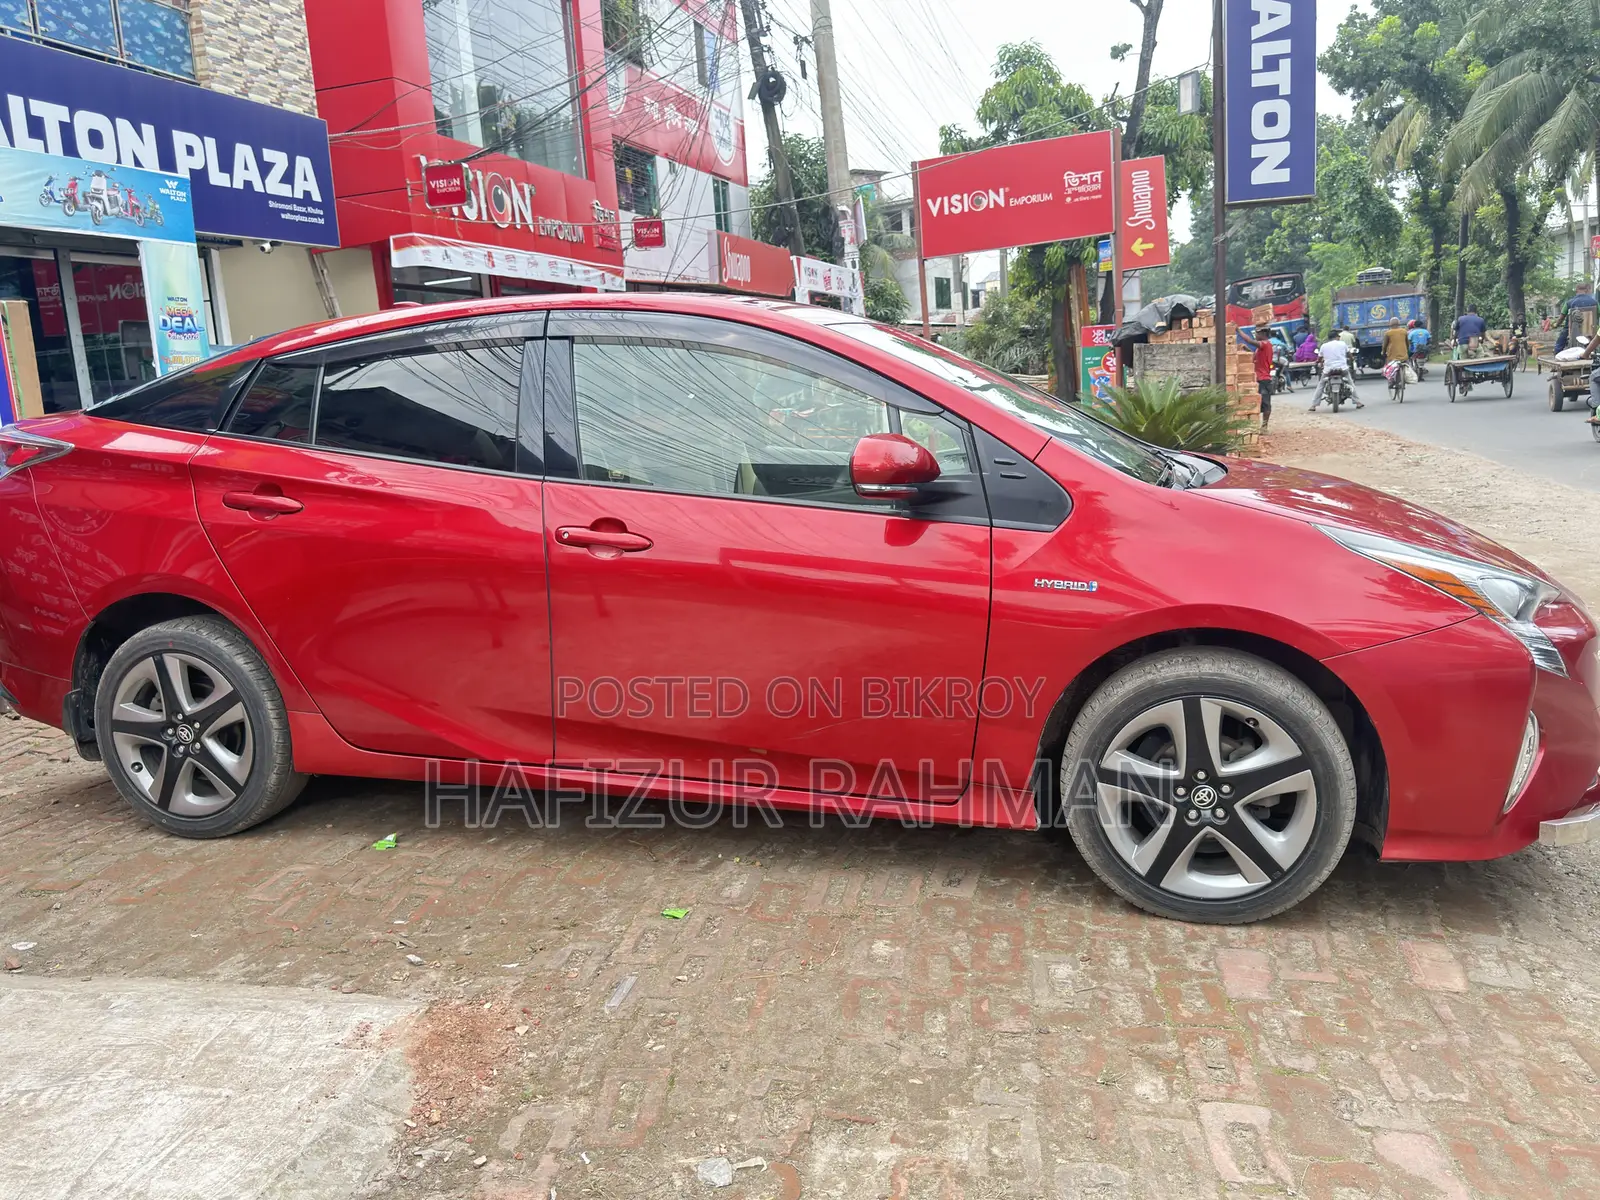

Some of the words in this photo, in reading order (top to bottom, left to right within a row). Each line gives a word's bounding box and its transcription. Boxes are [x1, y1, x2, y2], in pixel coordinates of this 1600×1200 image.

[0, 93, 160, 171] LTON
[172, 129, 322, 201] PLAZA
[430, 177, 461, 189] VISION
[1063, 170, 1105, 188] ভিশন
[159, 187, 187, 197] WALTON
[170, 195, 187, 203] PLAZA
[1126, 170, 1155, 230] Shwapno
[307, 206, 324, 215] Khulna
[927, 188, 1005, 217] VISION
[1009, 193, 1053, 207] EMPORIUM
[537, 215, 586, 244] EMPORIUM
[722, 236, 751, 287] Shwapno
[1242, 280, 1293, 295] EAGLE
[165, 306, 195, 317] MEGA
[159, 314, 206, 333] DEAL
[1034, 578, 1088, 591] HYBRID
